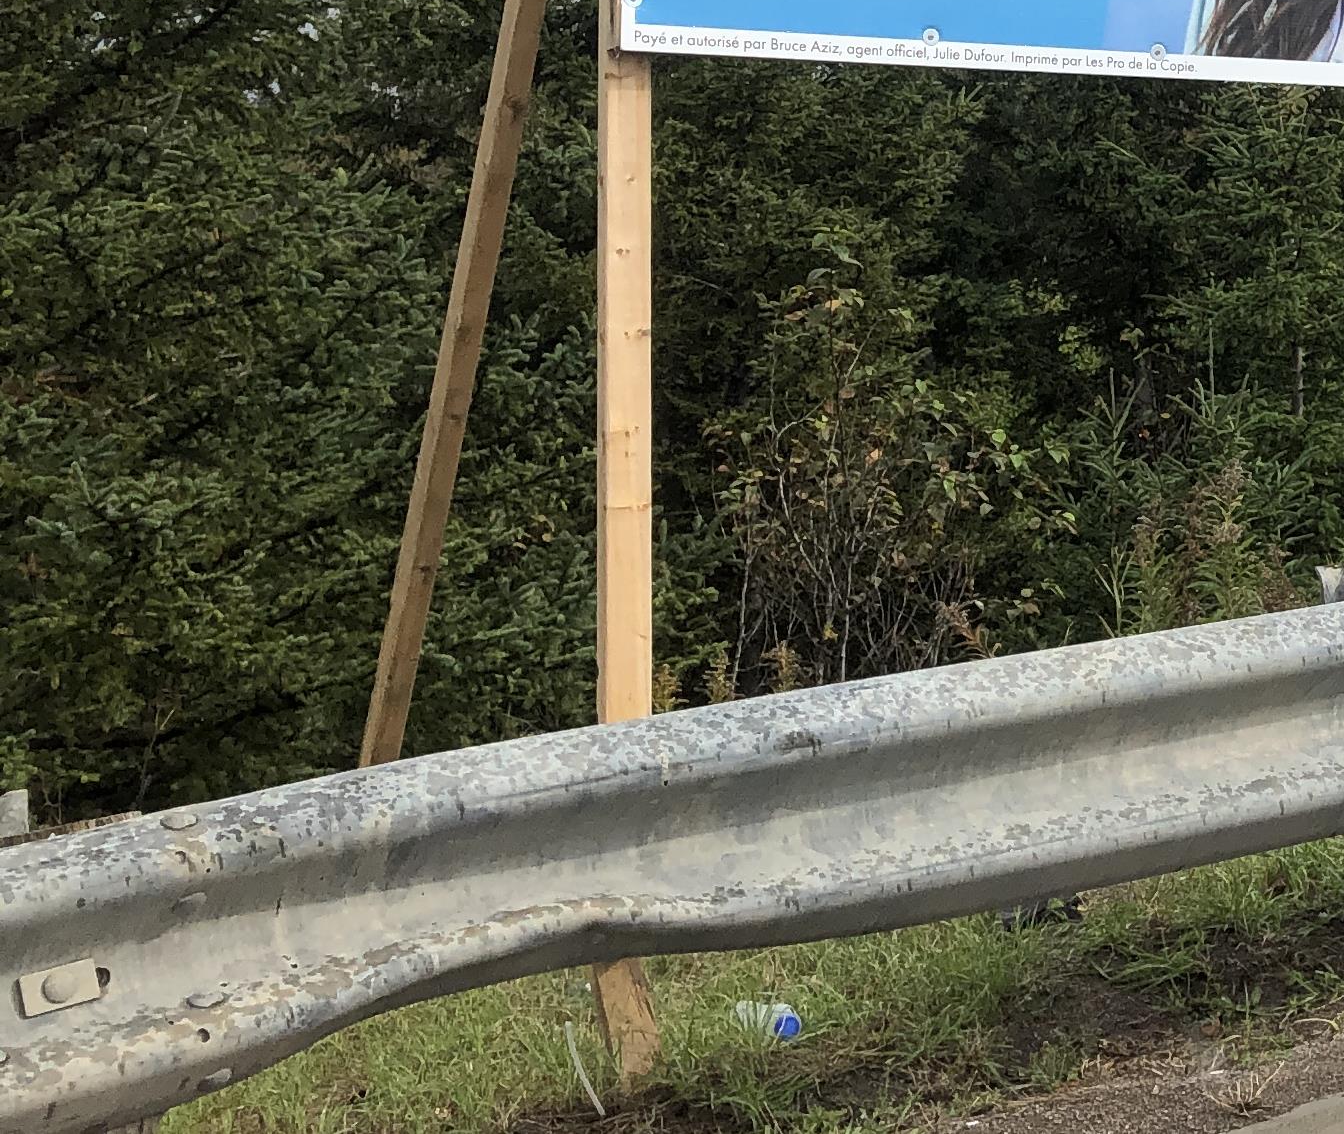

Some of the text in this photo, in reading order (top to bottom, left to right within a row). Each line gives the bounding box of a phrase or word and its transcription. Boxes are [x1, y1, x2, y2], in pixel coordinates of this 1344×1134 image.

[634, 30, 1199, 75] Payé et autorisé par Bruce Aziz, agent officiel, Julie Dufour. Imprimé par Les Pro de la Copie.
